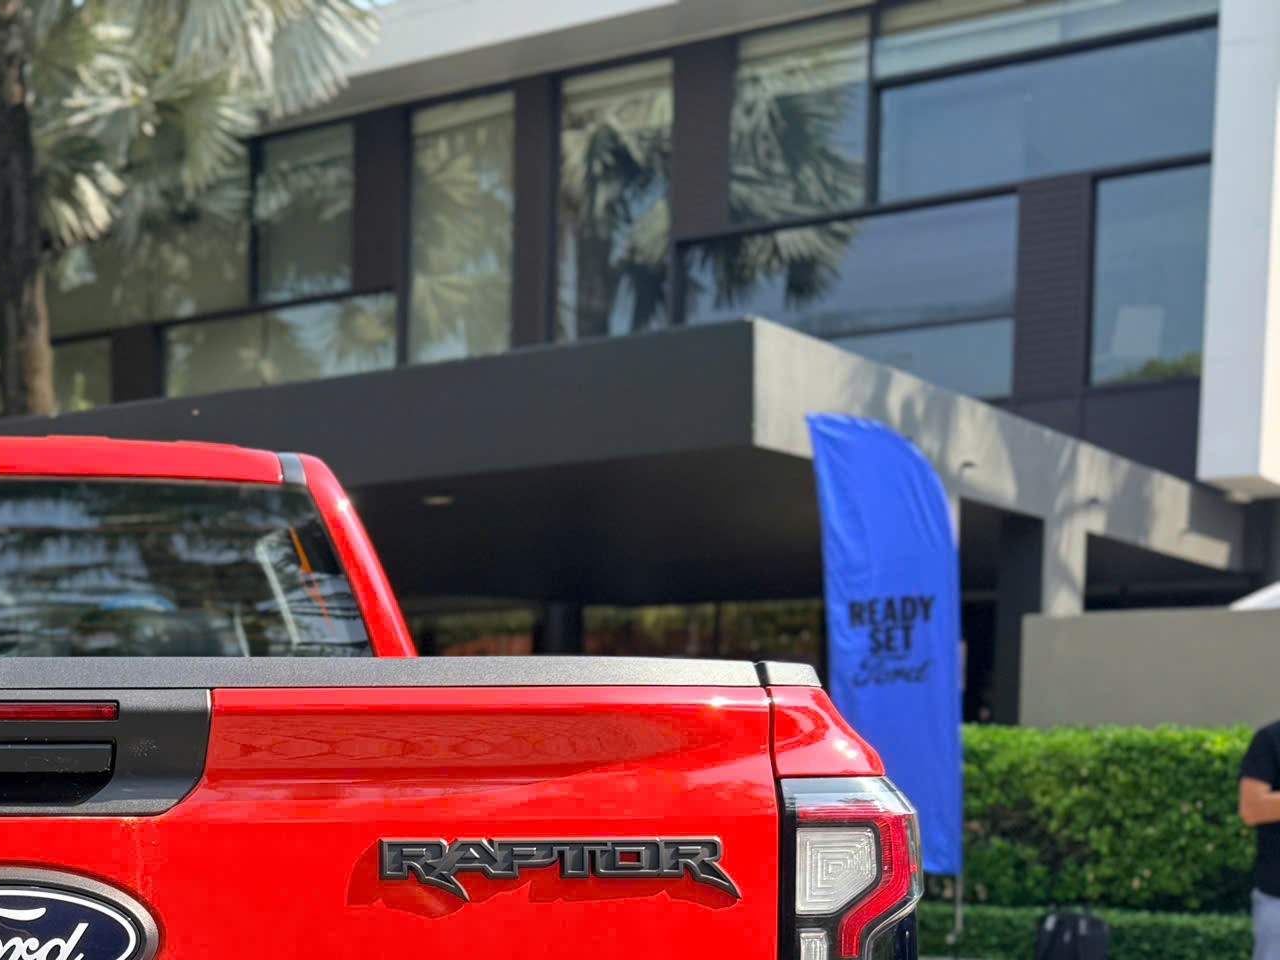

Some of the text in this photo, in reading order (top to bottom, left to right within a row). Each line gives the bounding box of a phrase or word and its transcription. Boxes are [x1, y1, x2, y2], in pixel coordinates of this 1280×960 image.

[849, 594, 935, 627] READY
[870, 625, 912, 655] SET
[852, 653, 935, 687] Ford
[378, 836, 742, 902] RAPTOR
